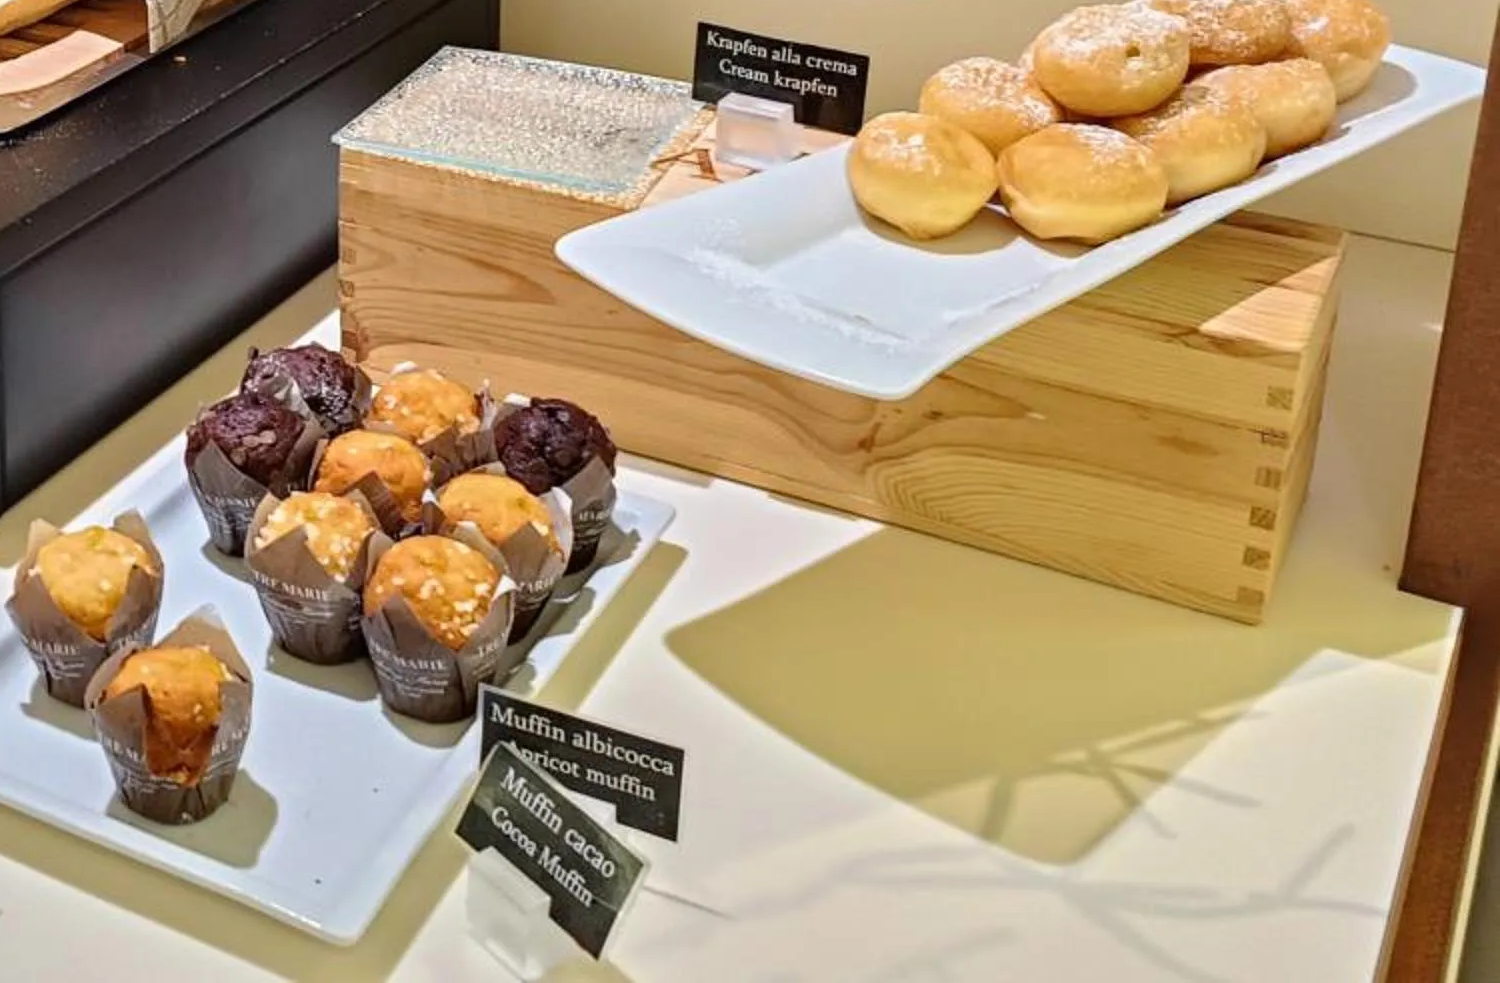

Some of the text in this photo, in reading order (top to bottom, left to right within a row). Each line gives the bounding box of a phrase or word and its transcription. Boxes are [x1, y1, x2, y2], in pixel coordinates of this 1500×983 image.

[706, 30, 858, 76] Krapfen alla crema
[719, 58, 838, 97] Cream krapfen
[281, 582, 329, 601] MARIE
[490, 701, 675, 776] Muffin albicocca
[586, 768, 656, 801] muffin
[500, 767, 616, 878] Muffin cacao
[491, 806, 594, 908] Cocoa Muffin
